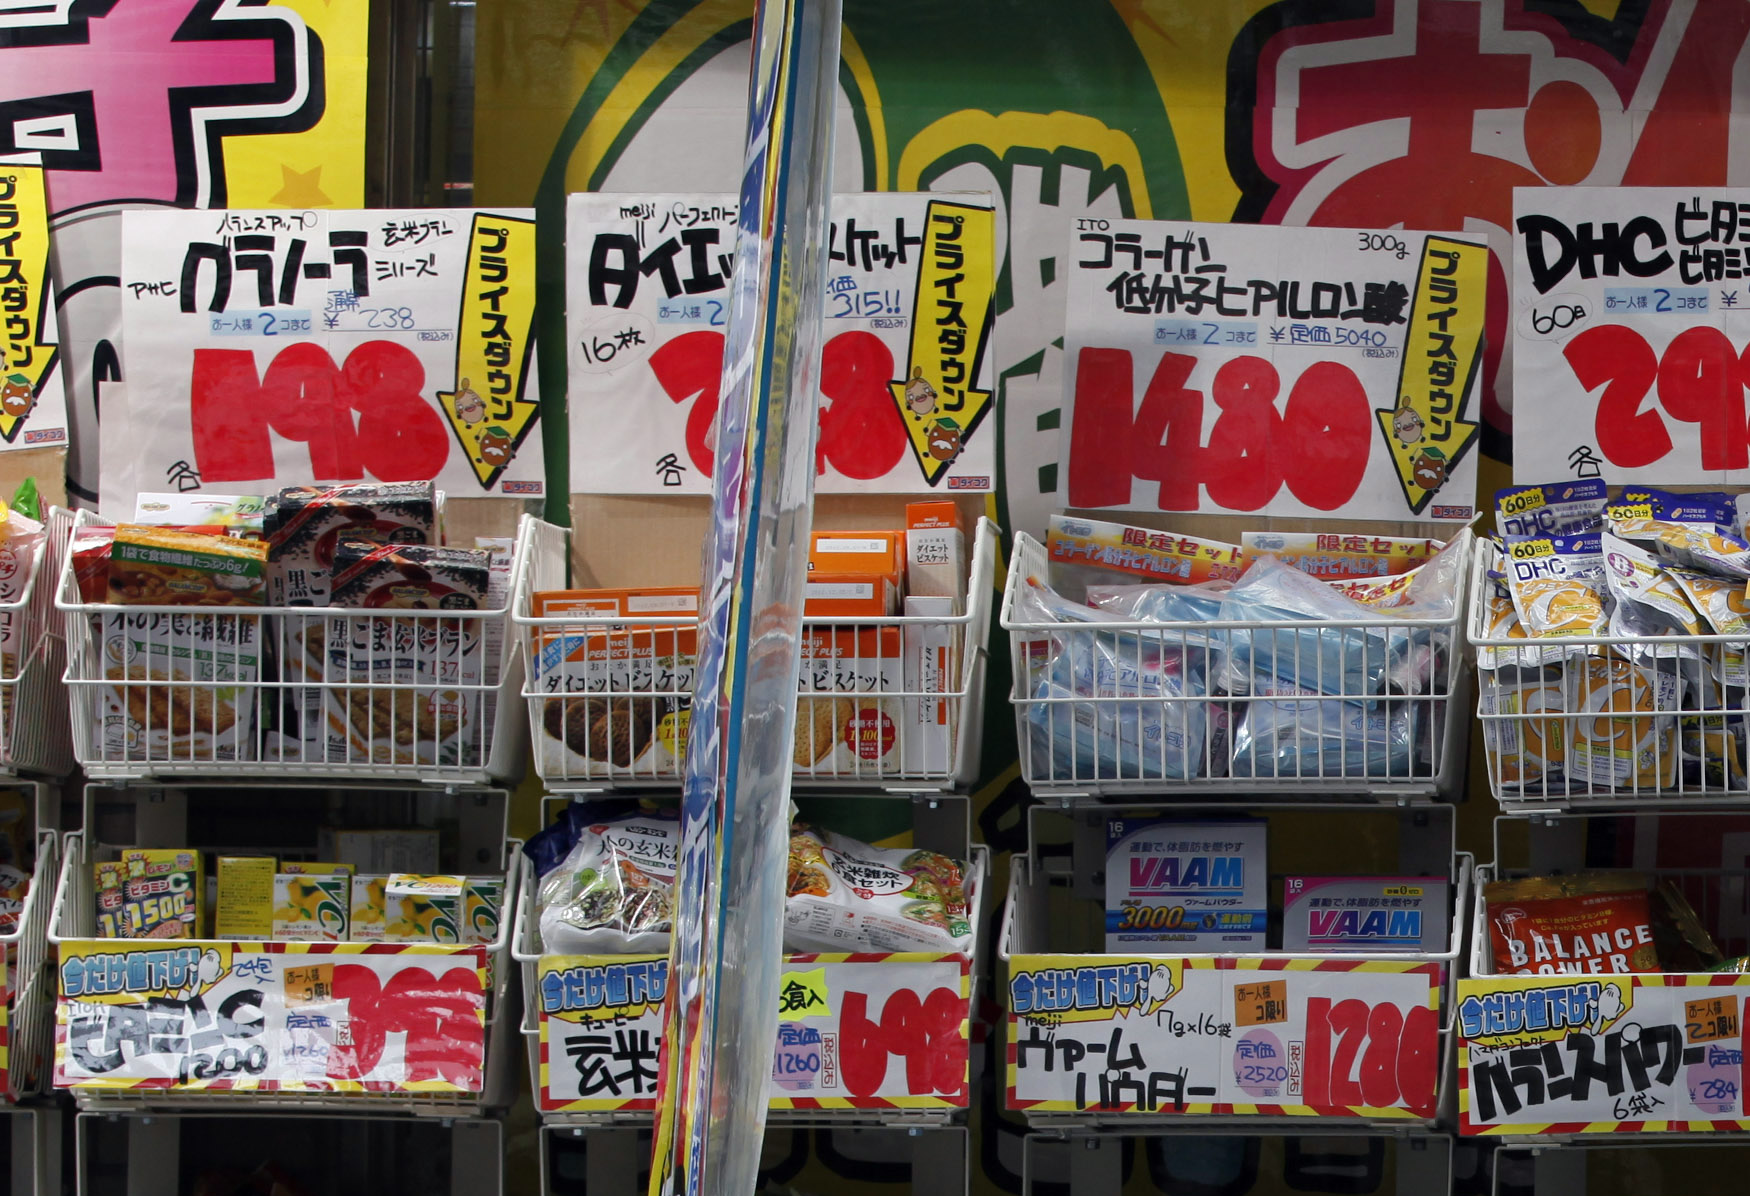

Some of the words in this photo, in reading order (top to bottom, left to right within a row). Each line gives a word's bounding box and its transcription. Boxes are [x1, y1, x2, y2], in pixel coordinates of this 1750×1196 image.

[620, 205, 656, 222] meiji
[1078, 219, 1109, 231] ITO
[1079, 231, 1227, 274] コラーゲン
[1359, 233, 1410, 259] 300g
[1516, 215, 1674, 294] DHC
[180, 231, 368, 313] グラノーラ
[933, 215, 965, 412] プライスダウン
[1107, 272, 1409, 325] 低分子ヒアルロン酸
[477, 229, 513, 420] プライスダウン
[1532, 305, 1586, 334] 60日
[581, 328, 645, 364] 16枚
[1428, 251, 1460, 441] プライスダウン
[1069, 347, 1372, 511] 1480
[168, 460, 201, 491] 各
[656, 454, 685, 485] 各
[1569, 446, 1602, 477] 各
[1504, 509, 1555, 538] DHC
[1513, 540, 1553, 558] 60日分
[1514, 560, 1566, 580] DHC
[1129, 857, 1244, 888] VAAM
[1308, 910, 1422, 938] VAAM
[1511, 925, 1654, 967] BALANCE
[1025, 1013, 1062, 1030] meiji
[839, 987, 969, 1096] 698
[1236, 1041, 1276, 1060] 定価
[1303, 997, 1437, 1119] 1280
[1473, 1023, 1706, 1122] バランスパワー
